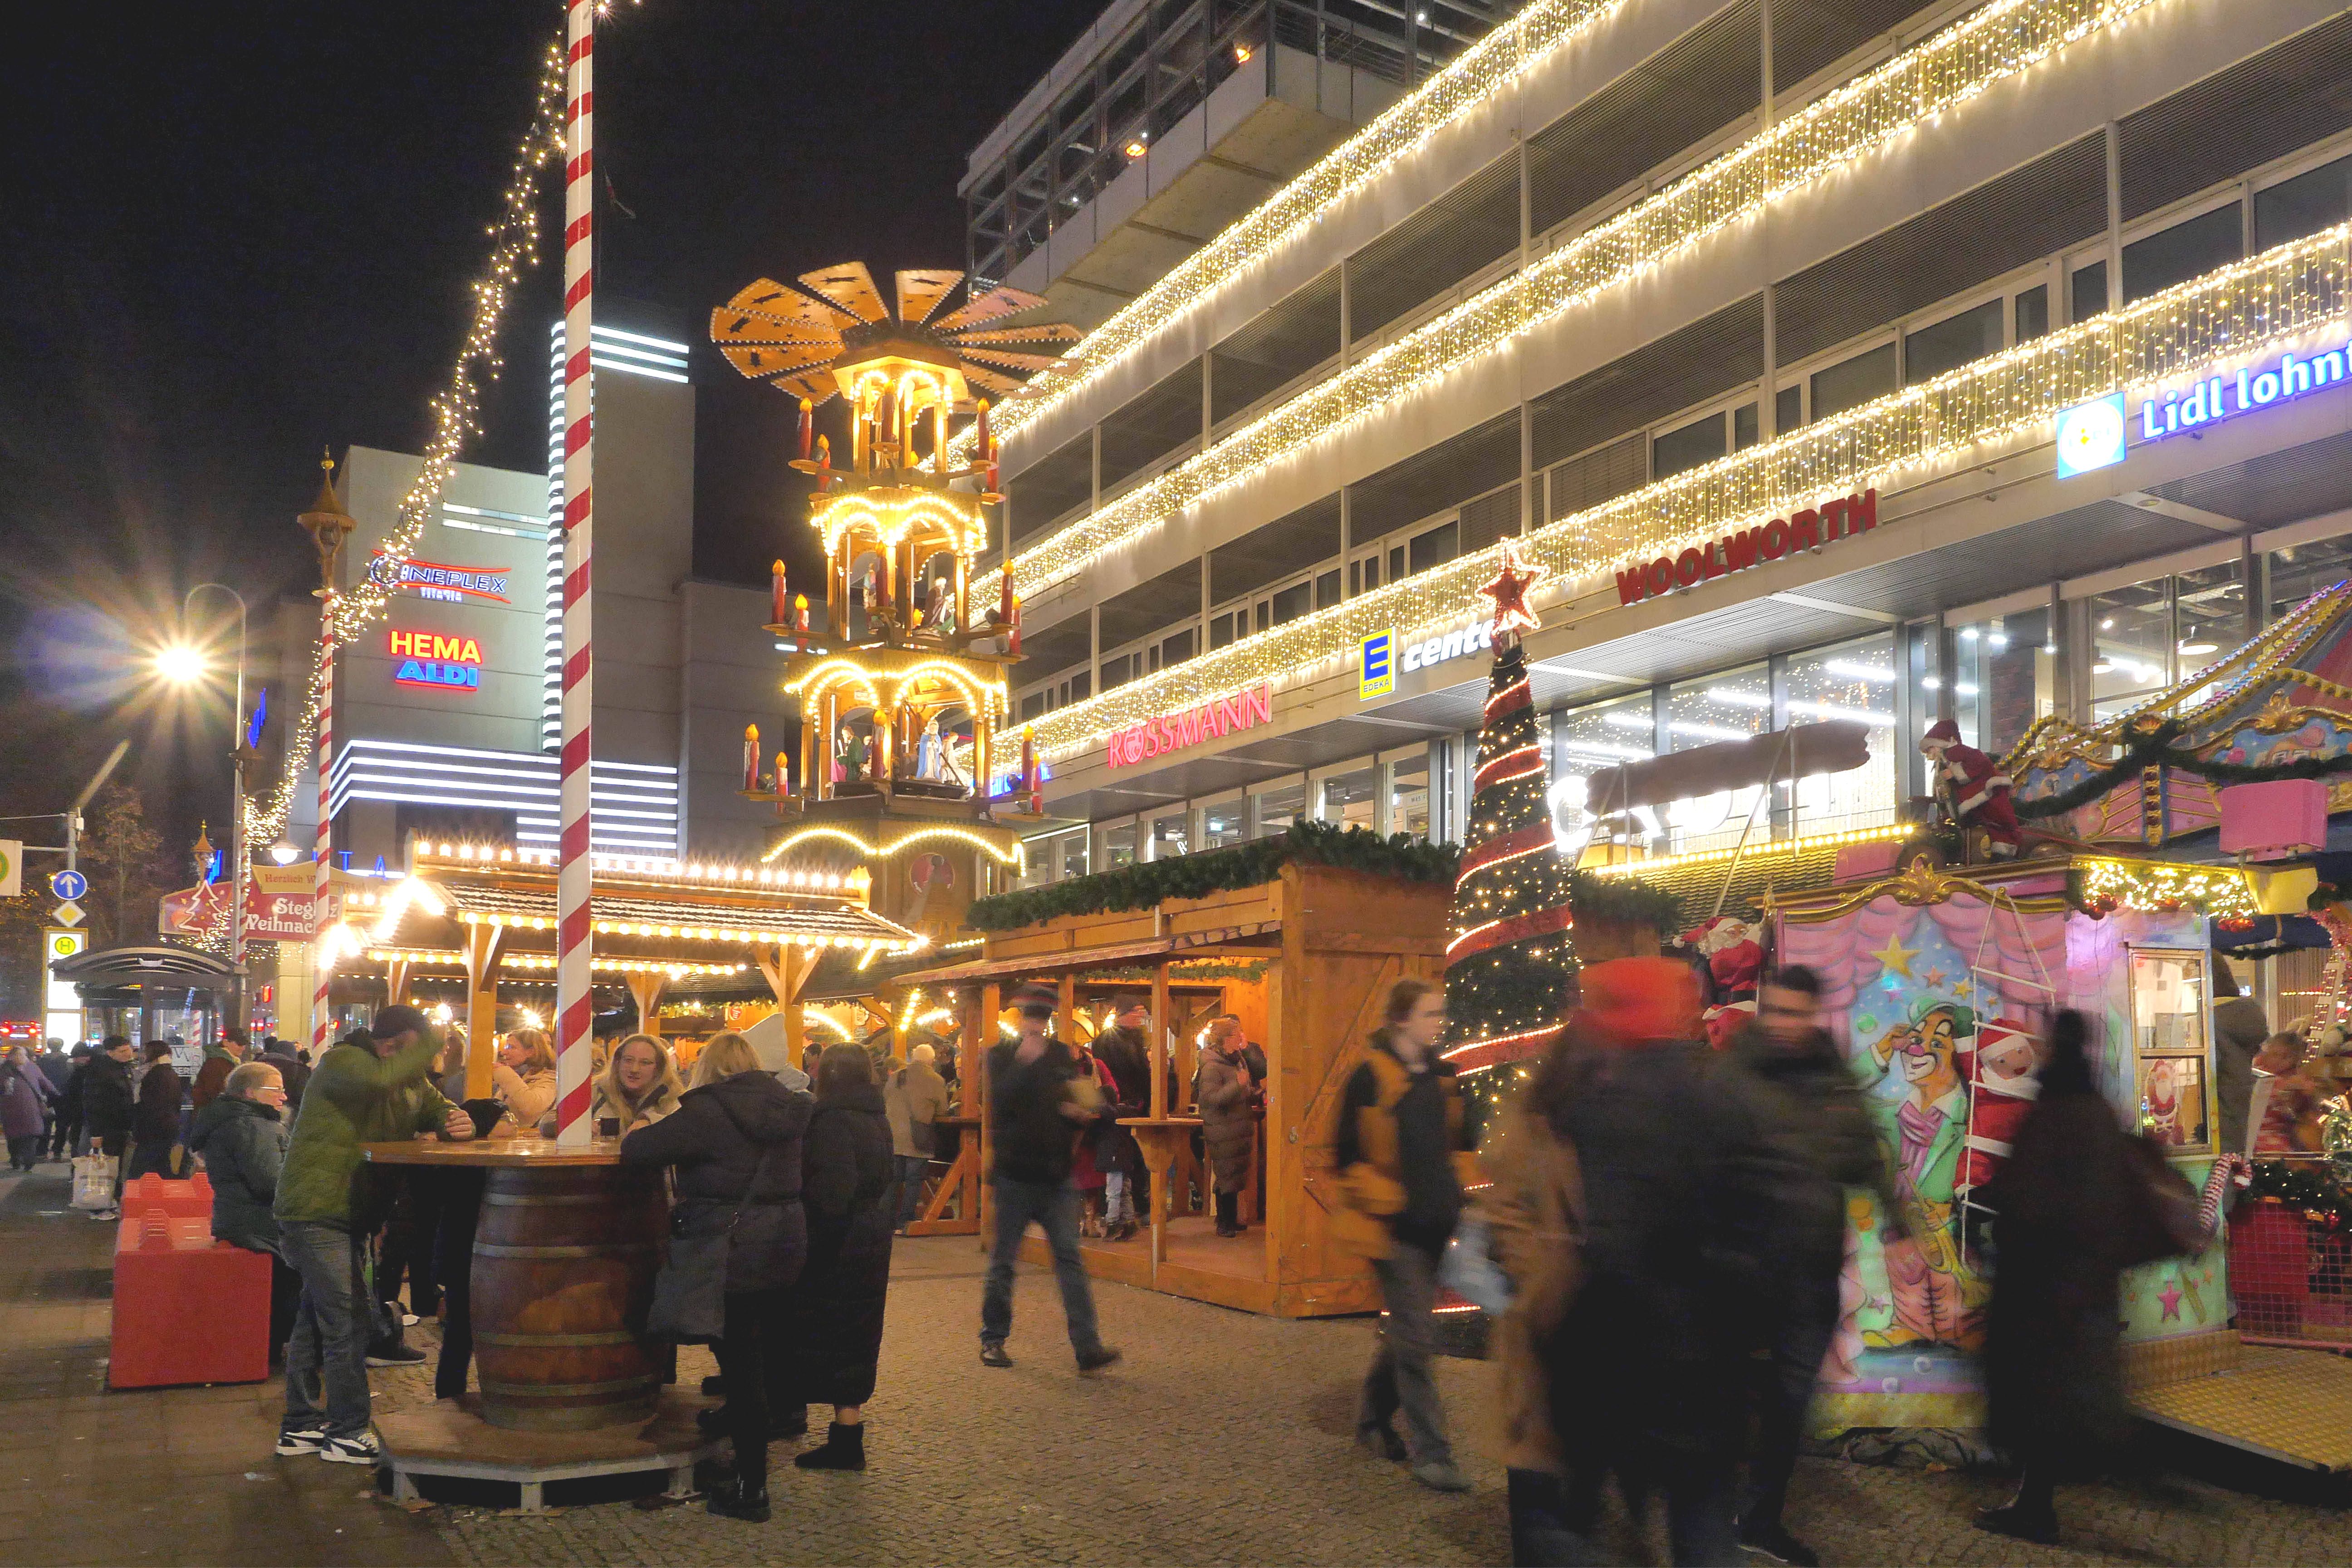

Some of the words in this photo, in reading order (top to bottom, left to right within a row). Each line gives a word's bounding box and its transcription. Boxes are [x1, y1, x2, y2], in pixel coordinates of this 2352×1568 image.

[2143, 377, 2225, 439] Lidl
[1615, 488, 1876, 606] WOOLWORTH
[370, 554, 507, 593] CINEPLEX
[391, 631, 481, 663] HEMA
[1404, 619, 1494, 672] cente
[396, 661, 478, 687] ALDI
[1363, 678, 1390, 693] EDEKA
[1108, 682, 1269, 769] ROSSMANN
[265, 874, 304, 883] Herzlich
[60, 941, 70, 951] H
